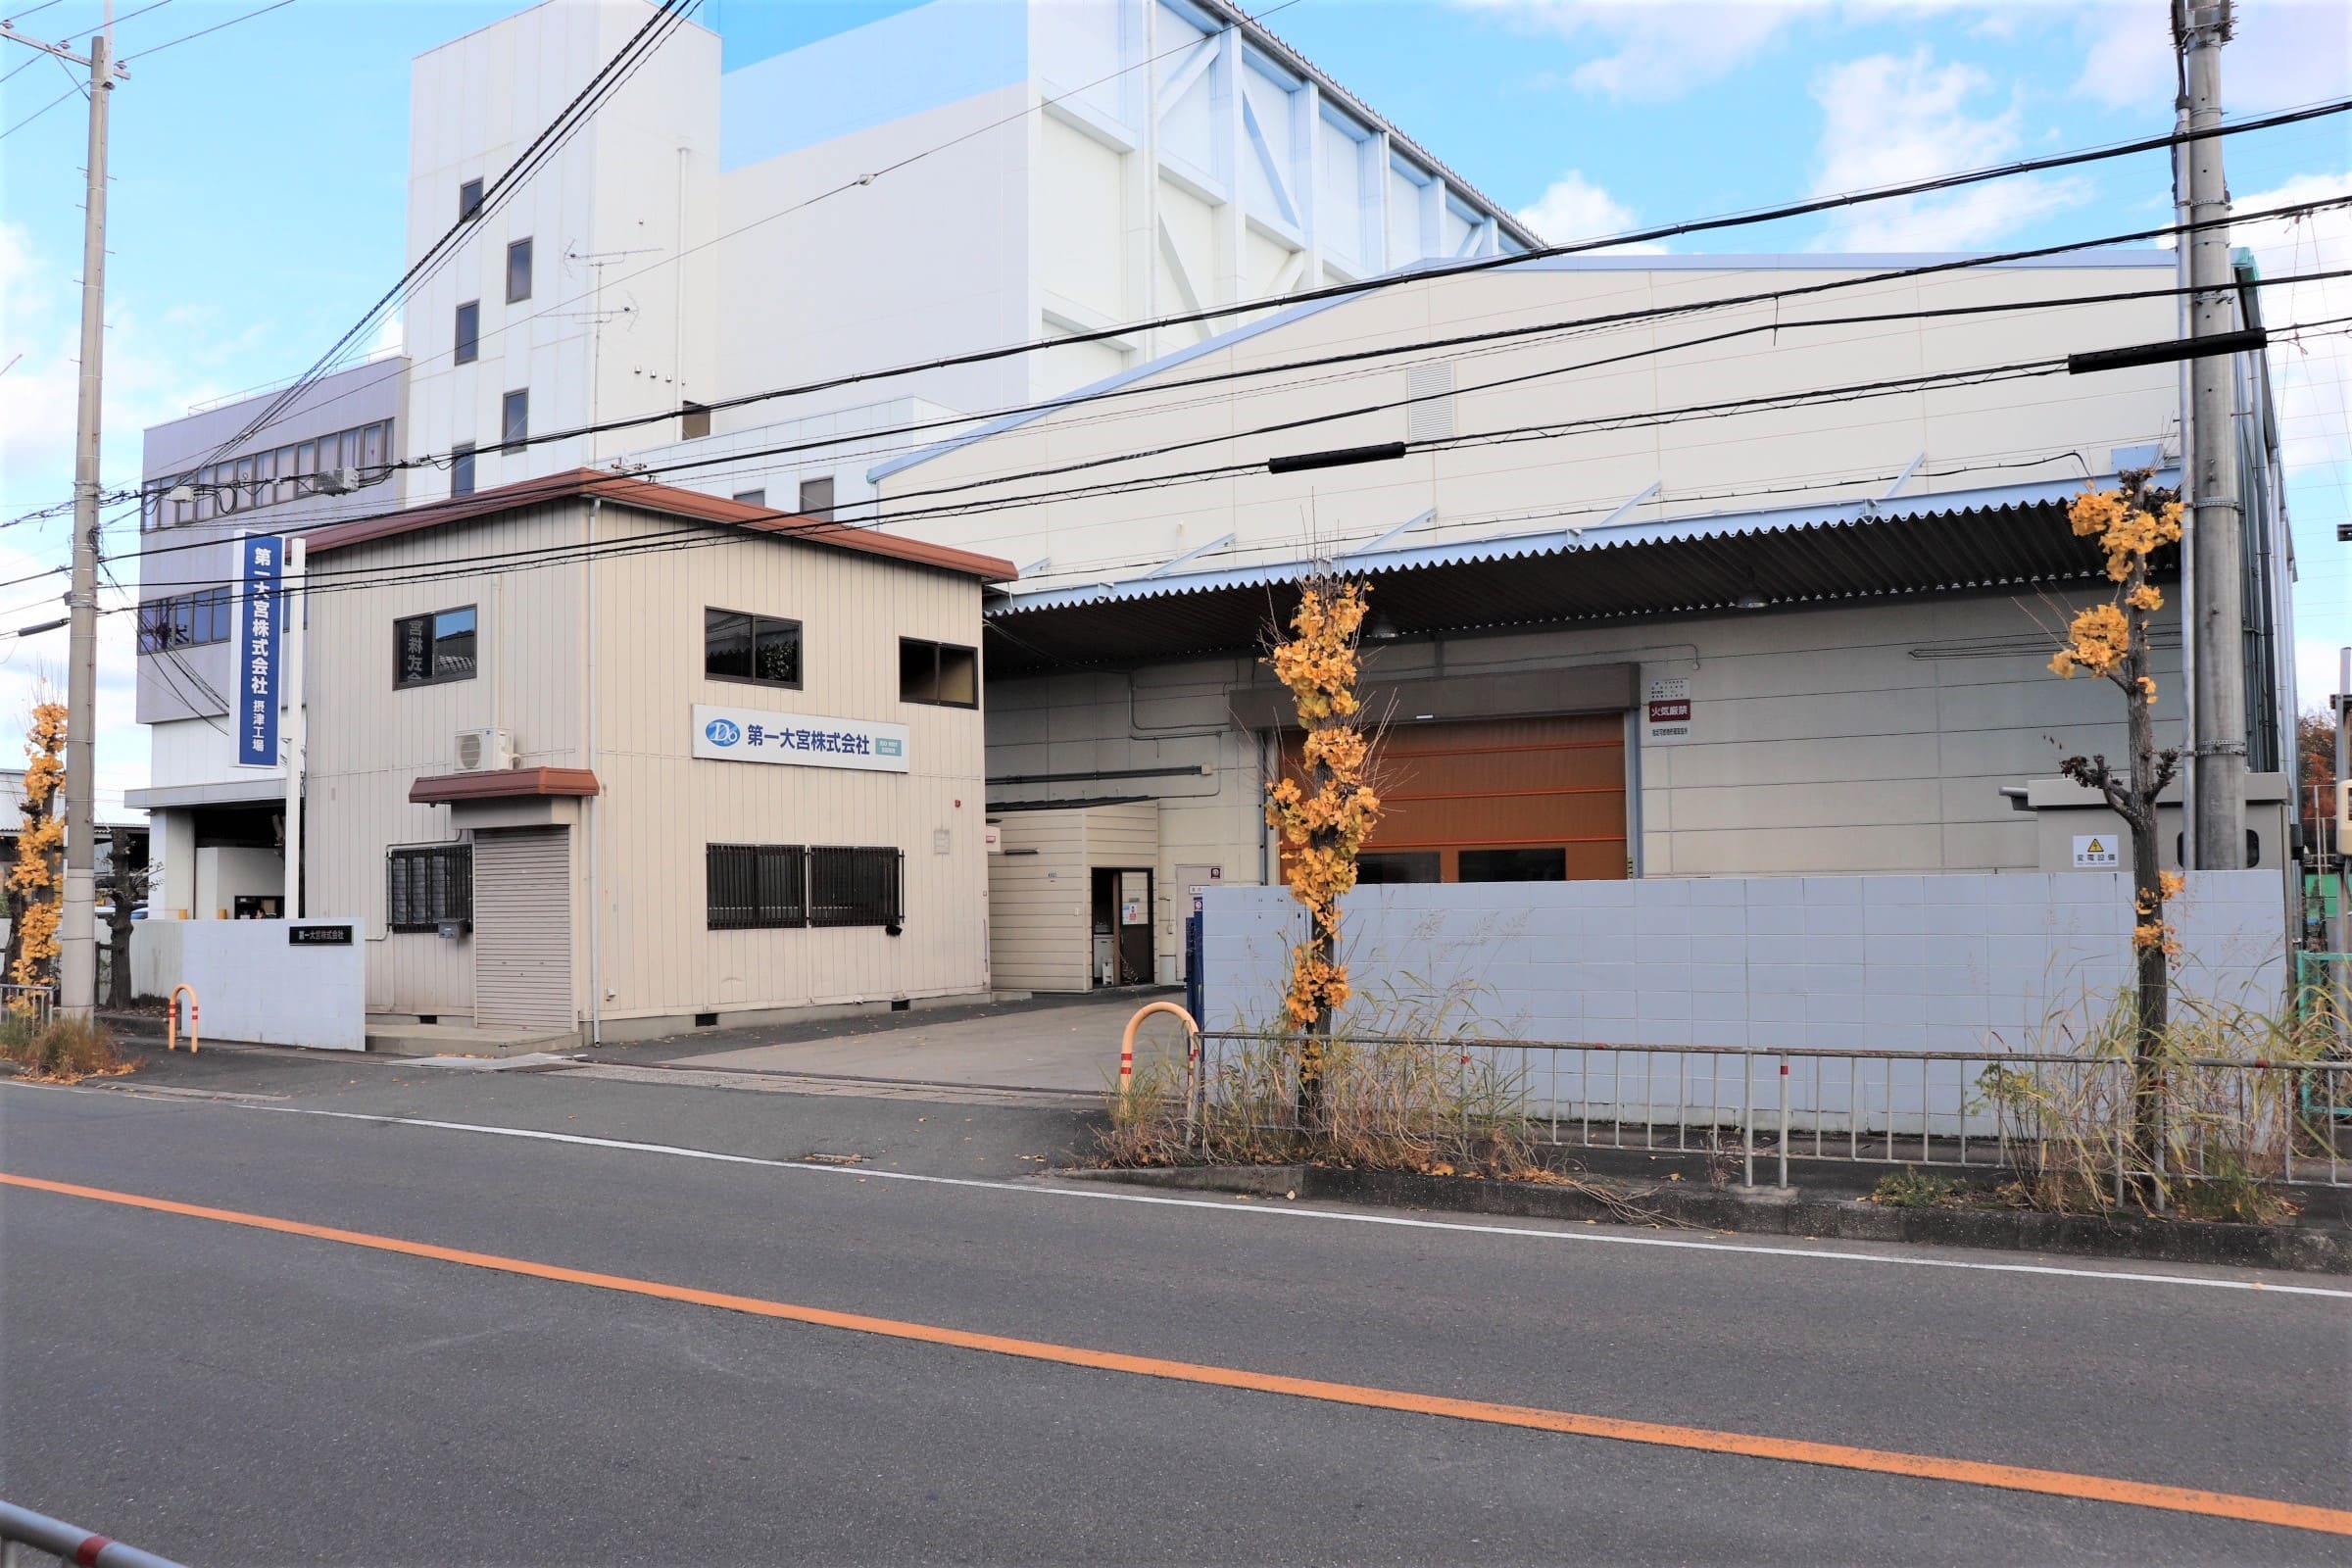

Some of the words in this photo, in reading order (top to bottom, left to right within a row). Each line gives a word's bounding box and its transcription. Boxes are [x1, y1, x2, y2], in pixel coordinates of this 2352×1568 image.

[251, 547, 271, 695] 第一大宮株式会社
[252, 700, 266, 753] 摂津工場
[1650, 705, 1689, 716] 火気厳禁
[748, 724, 870, 755] 第一大宮株式会社
